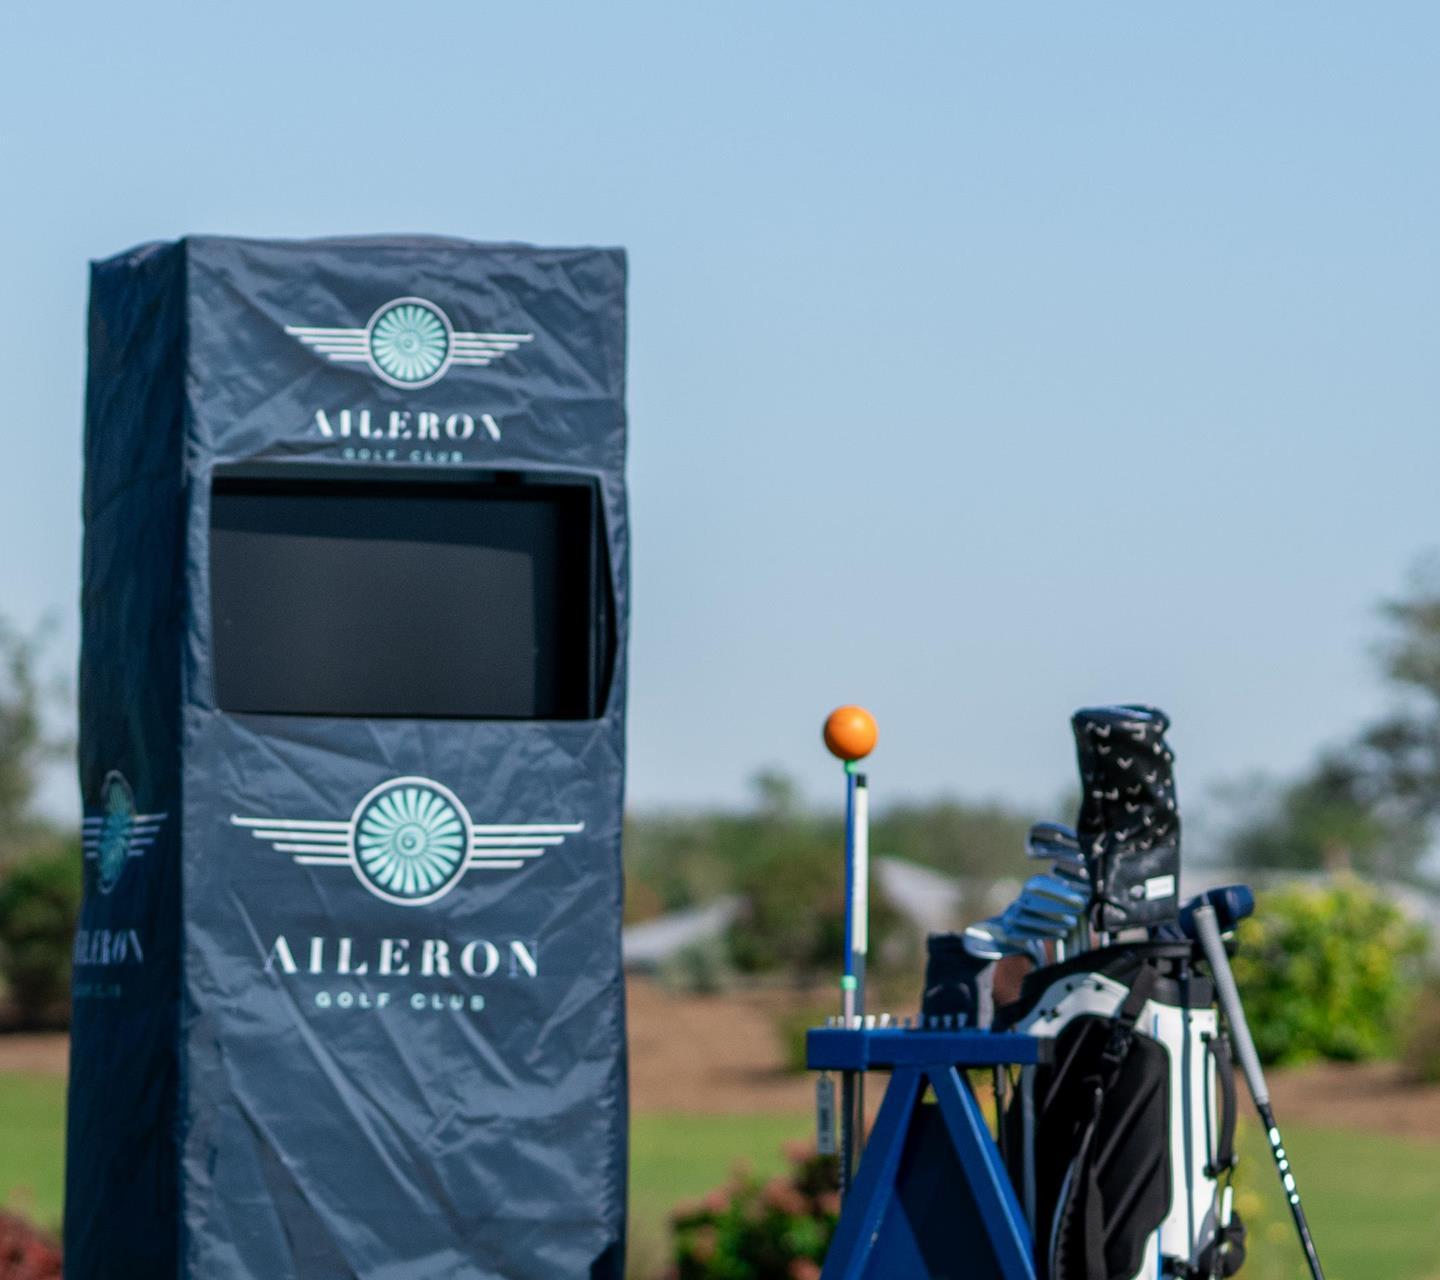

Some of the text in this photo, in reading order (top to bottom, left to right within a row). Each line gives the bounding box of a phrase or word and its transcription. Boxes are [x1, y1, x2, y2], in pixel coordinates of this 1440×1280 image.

[311, 408, 504, 442] AILERON
[343, 448, 464, 464] GOLF CLUB
[263, 934, 538, 979] AILERON
[315, 991, 486, 1012] GOLF CLUB
